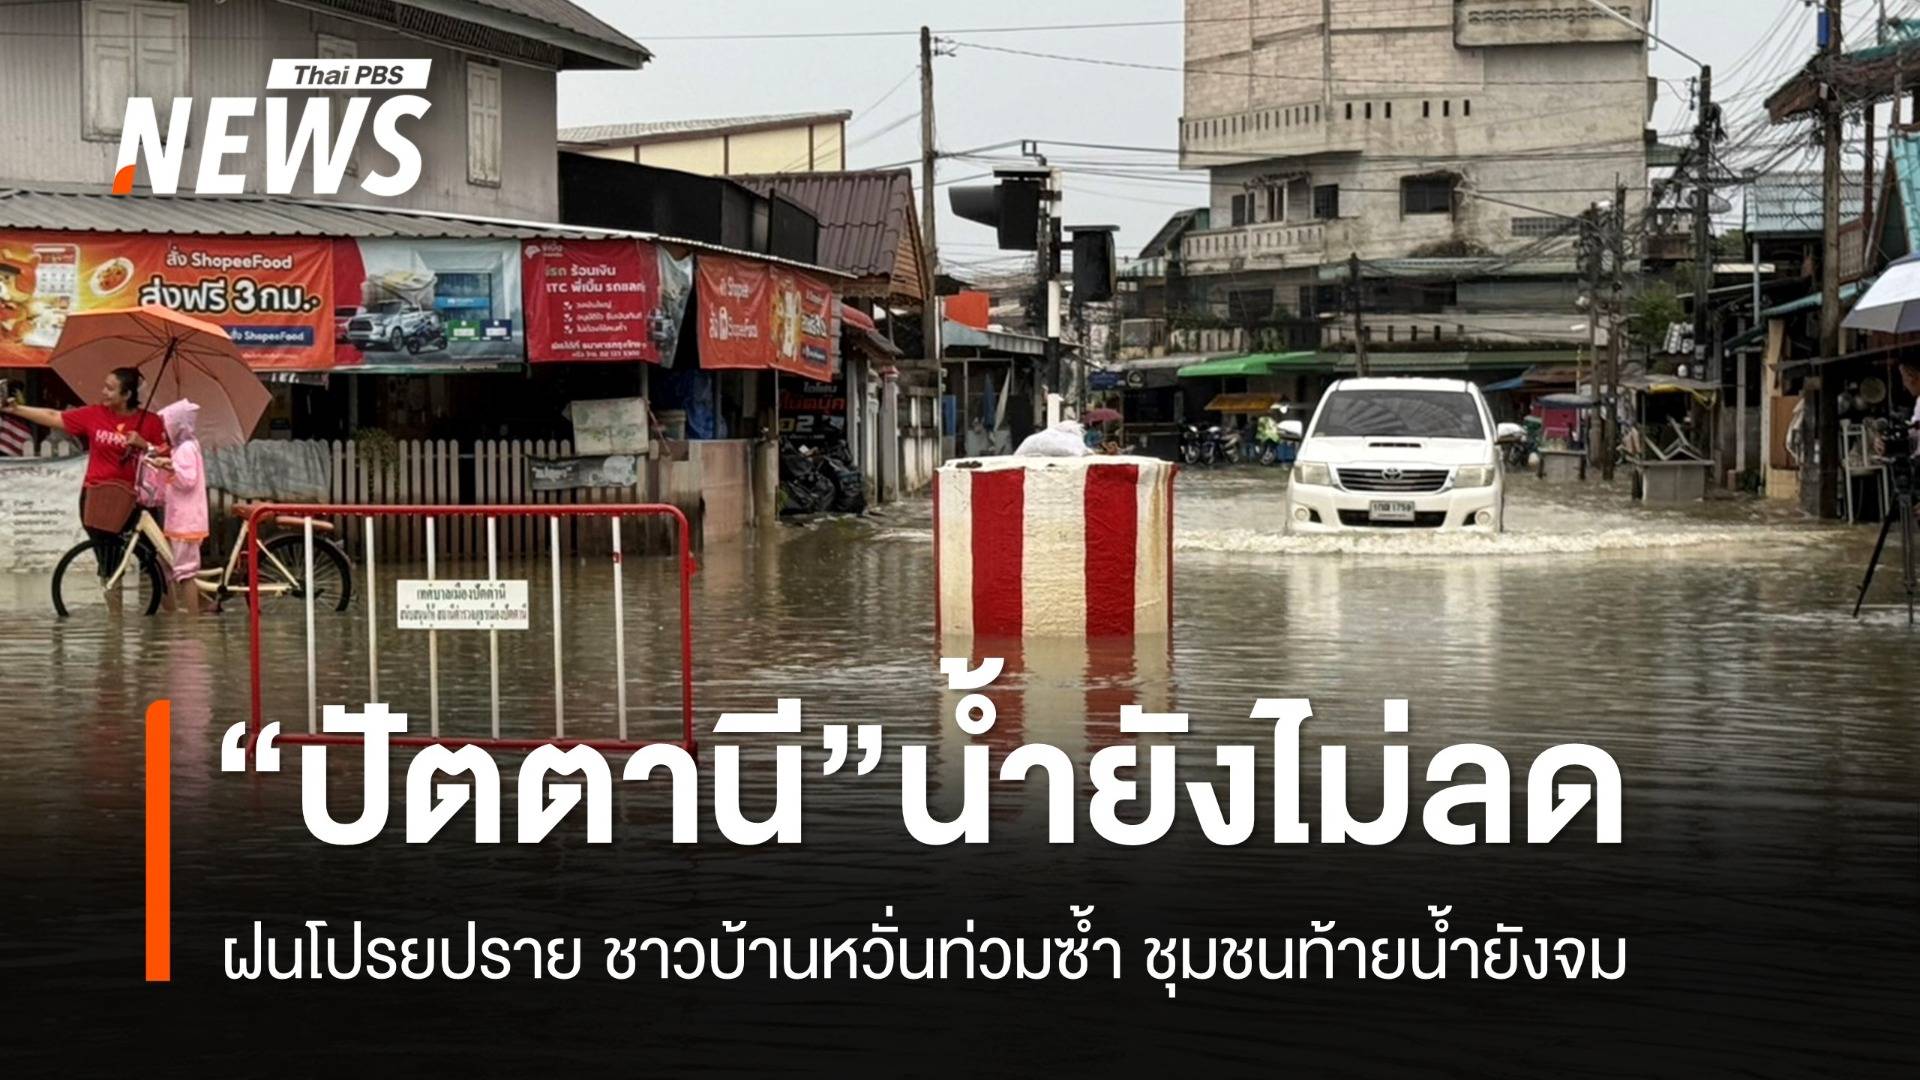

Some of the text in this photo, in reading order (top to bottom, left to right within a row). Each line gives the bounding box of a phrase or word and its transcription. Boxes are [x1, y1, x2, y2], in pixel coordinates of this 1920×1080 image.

[166, 245, 293, 271] สั่ง ShopeeFood
[571, 263, 617, 277] ร้อนเงิน
[140, 276, 228, 311] ส่งฟรี
[244, 331, 304, 343] ShopeeFood
[416, 582, 506, 600] เทศบาลเมืองปัตตานี
